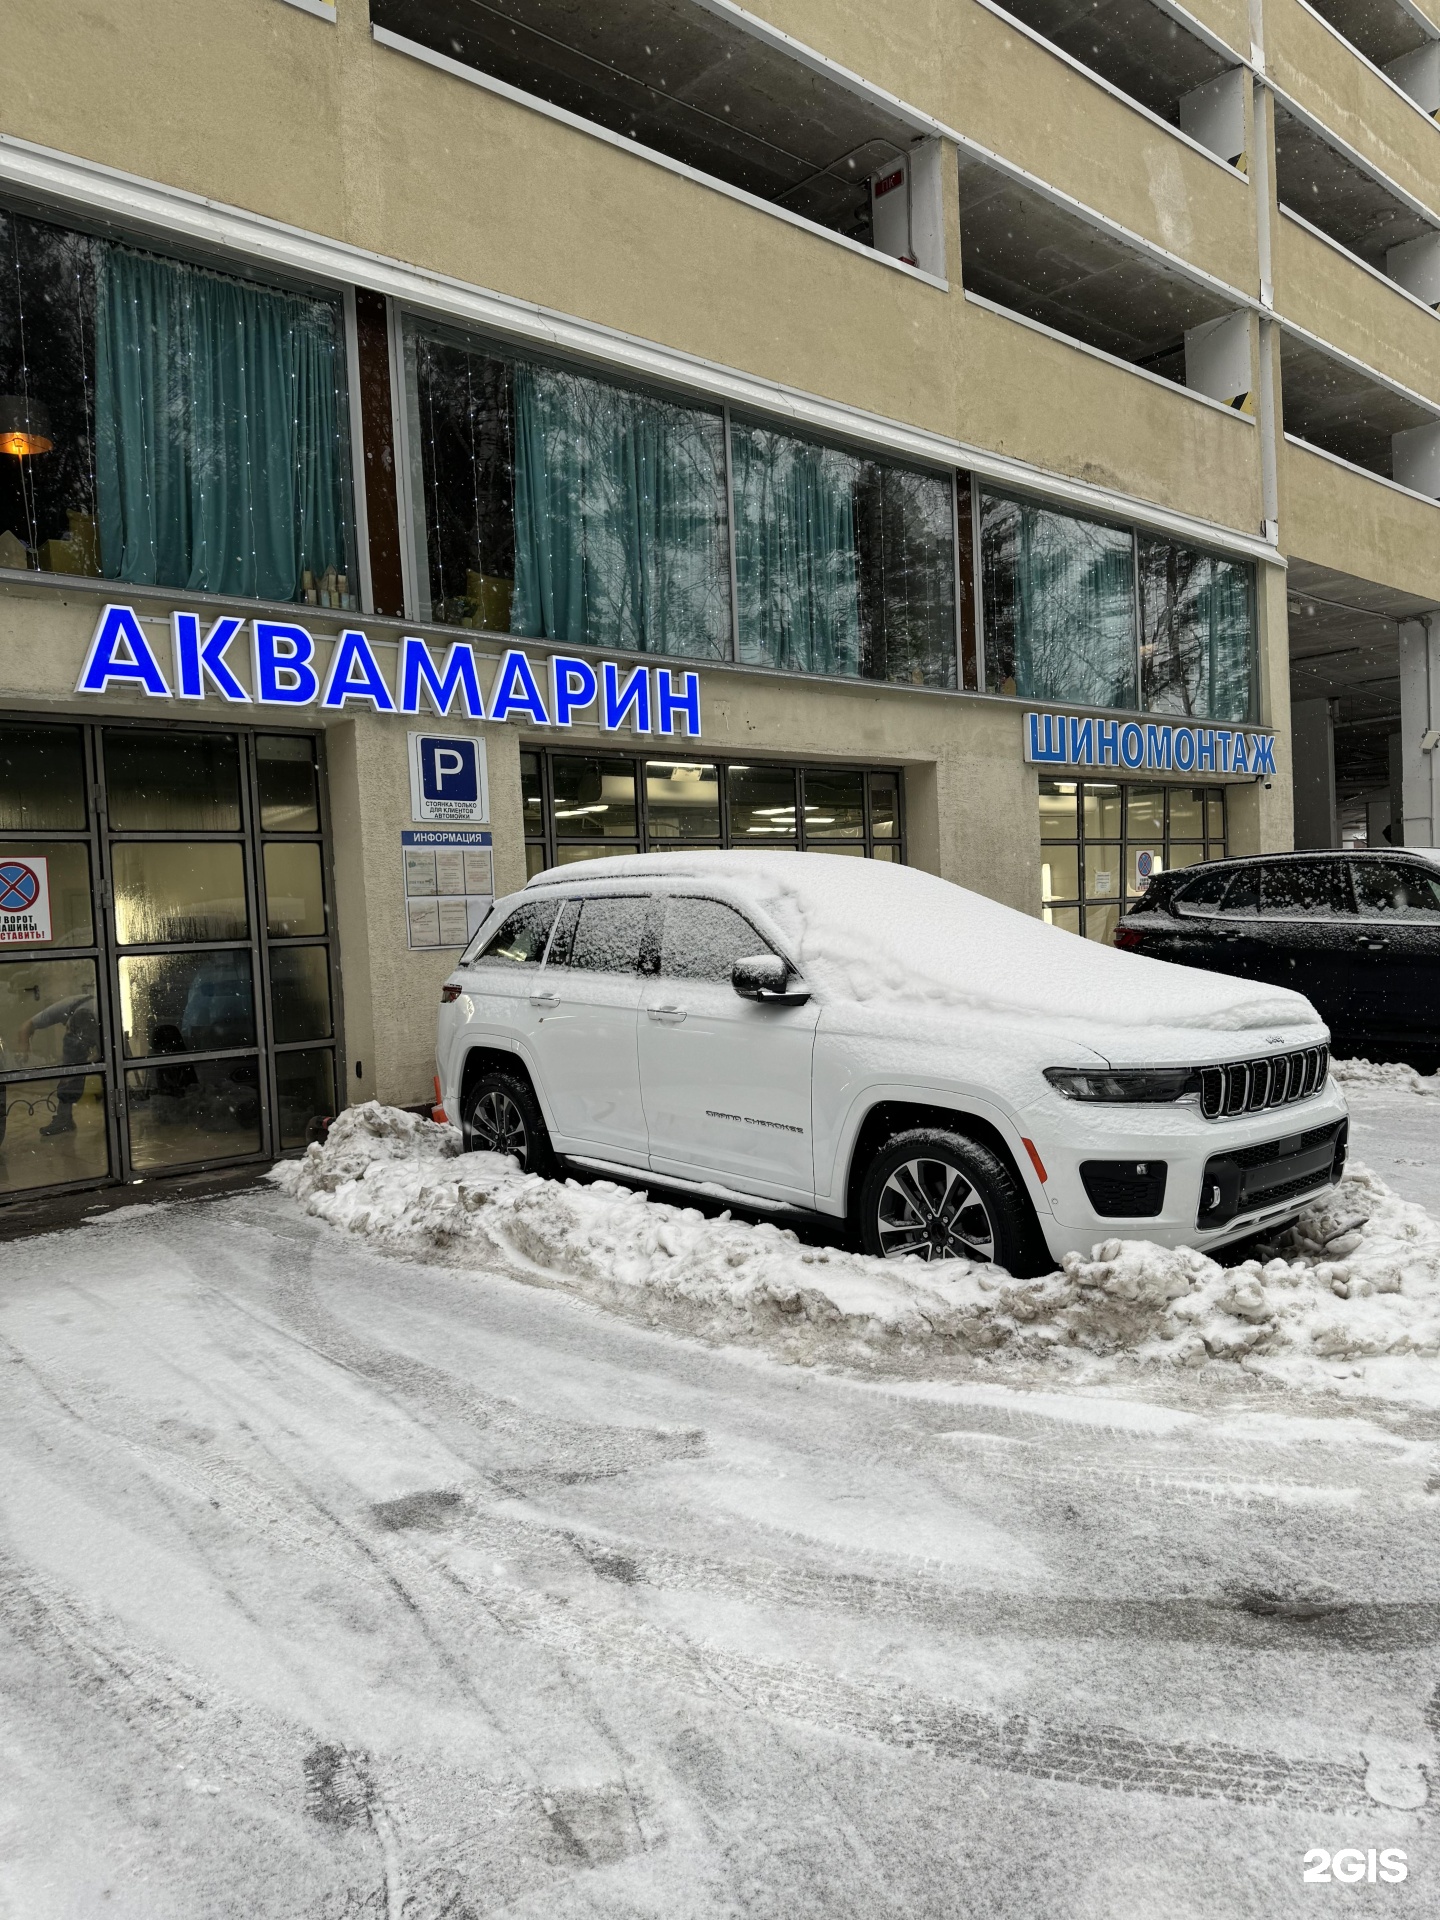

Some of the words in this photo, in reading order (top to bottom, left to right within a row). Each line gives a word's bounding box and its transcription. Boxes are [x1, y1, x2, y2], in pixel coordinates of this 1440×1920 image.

[75, 602, 702, 738] АКВАМАРИН
[1025, 712, 1277, 775] ШИНОМОНТАЖ
[413, 832, 482, 844] ИНФОРМАЦИЯ
[4, 915, 34, 924] ВОРОТ
[0, 923, 37, 932] АШИНЫ
[0, 931, 45, 940] СТАВИТЬ!
[705, 1110, 742, 1123] GRAND
[743, 1117, 804, 1134] CHEROKEE
